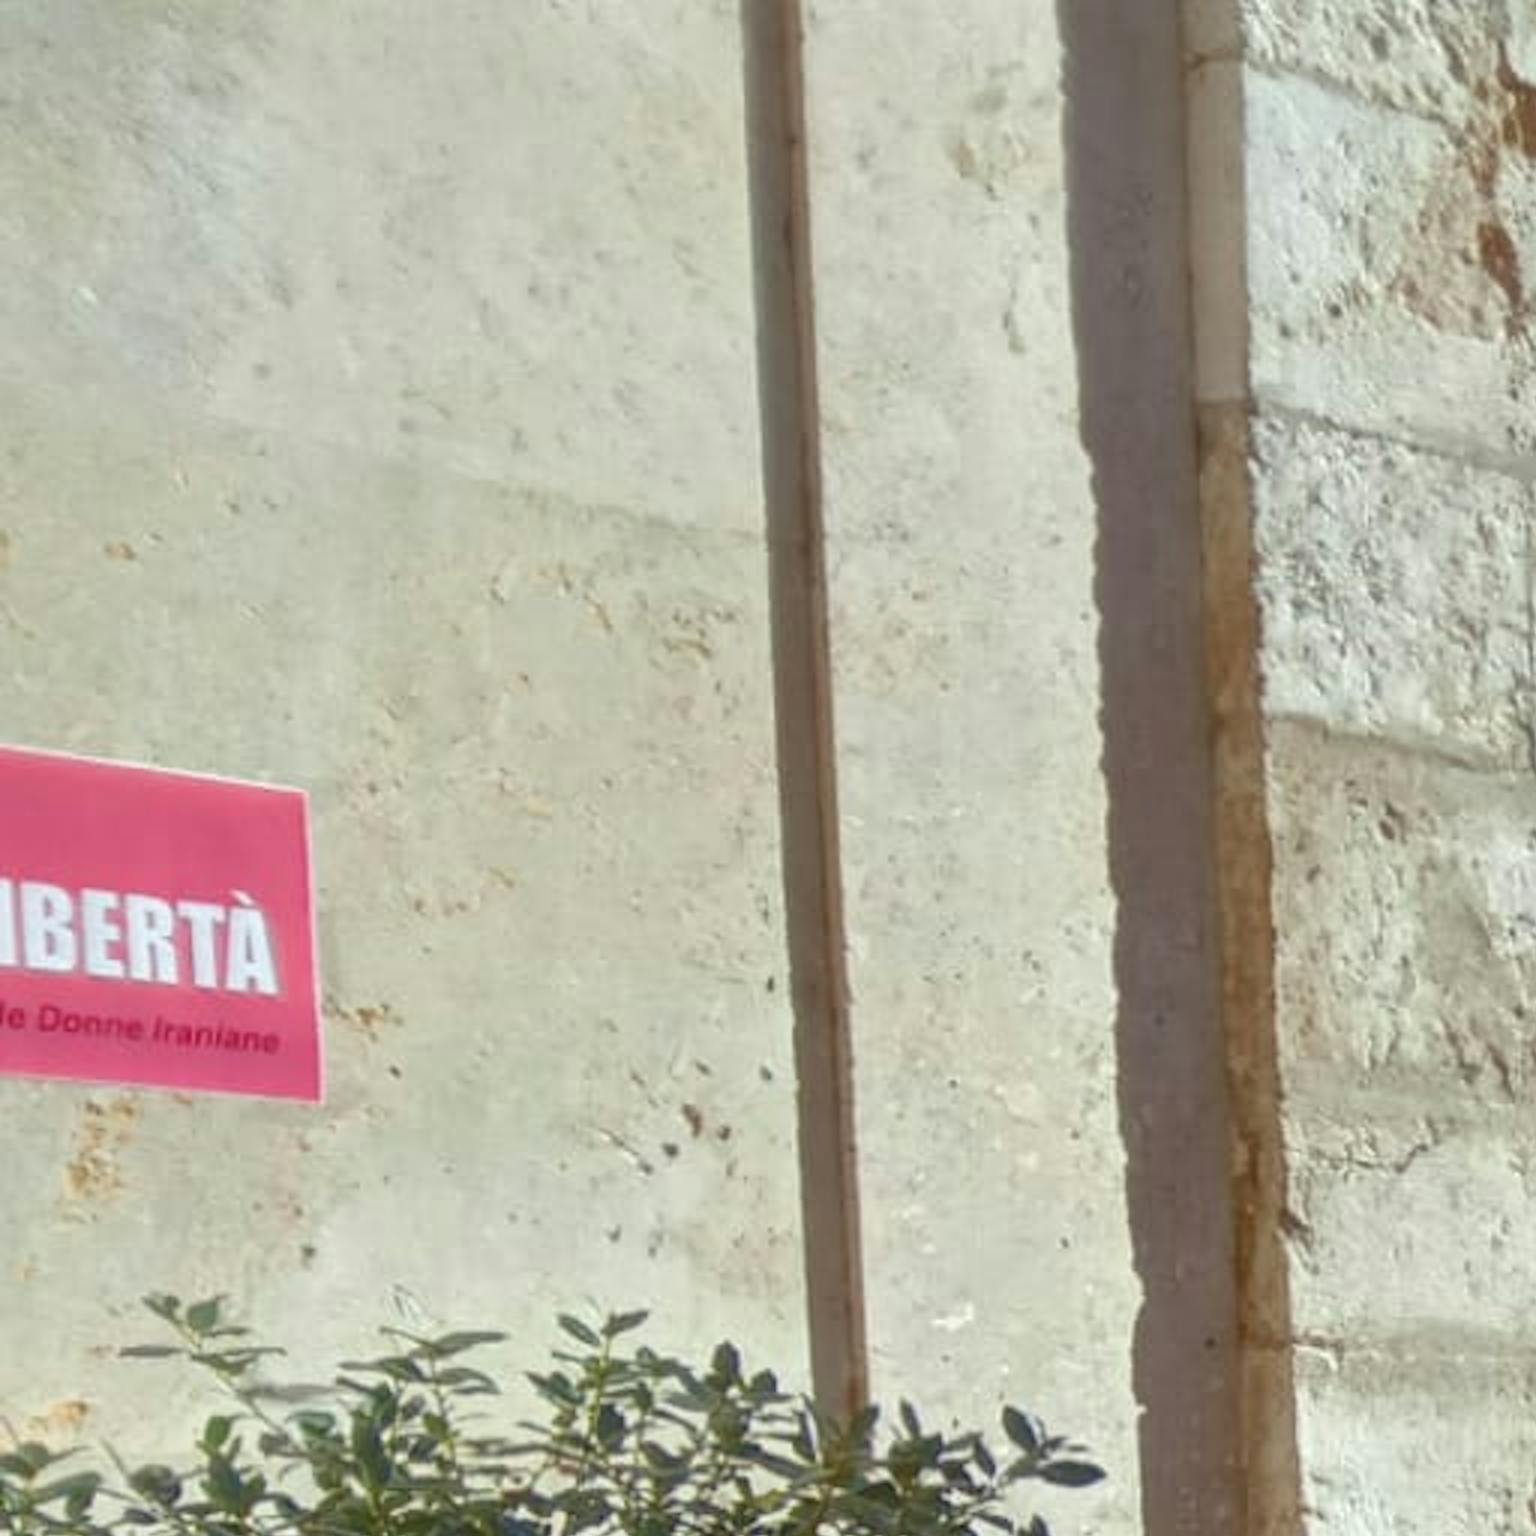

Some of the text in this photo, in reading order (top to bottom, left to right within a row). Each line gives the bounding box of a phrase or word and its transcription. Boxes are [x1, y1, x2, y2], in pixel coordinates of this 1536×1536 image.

[0, 877, 281, 996] IBERTÀ
[37, 1005, 143, 1042] Donne
[153, 1017, 281, 1055] Iraniane
